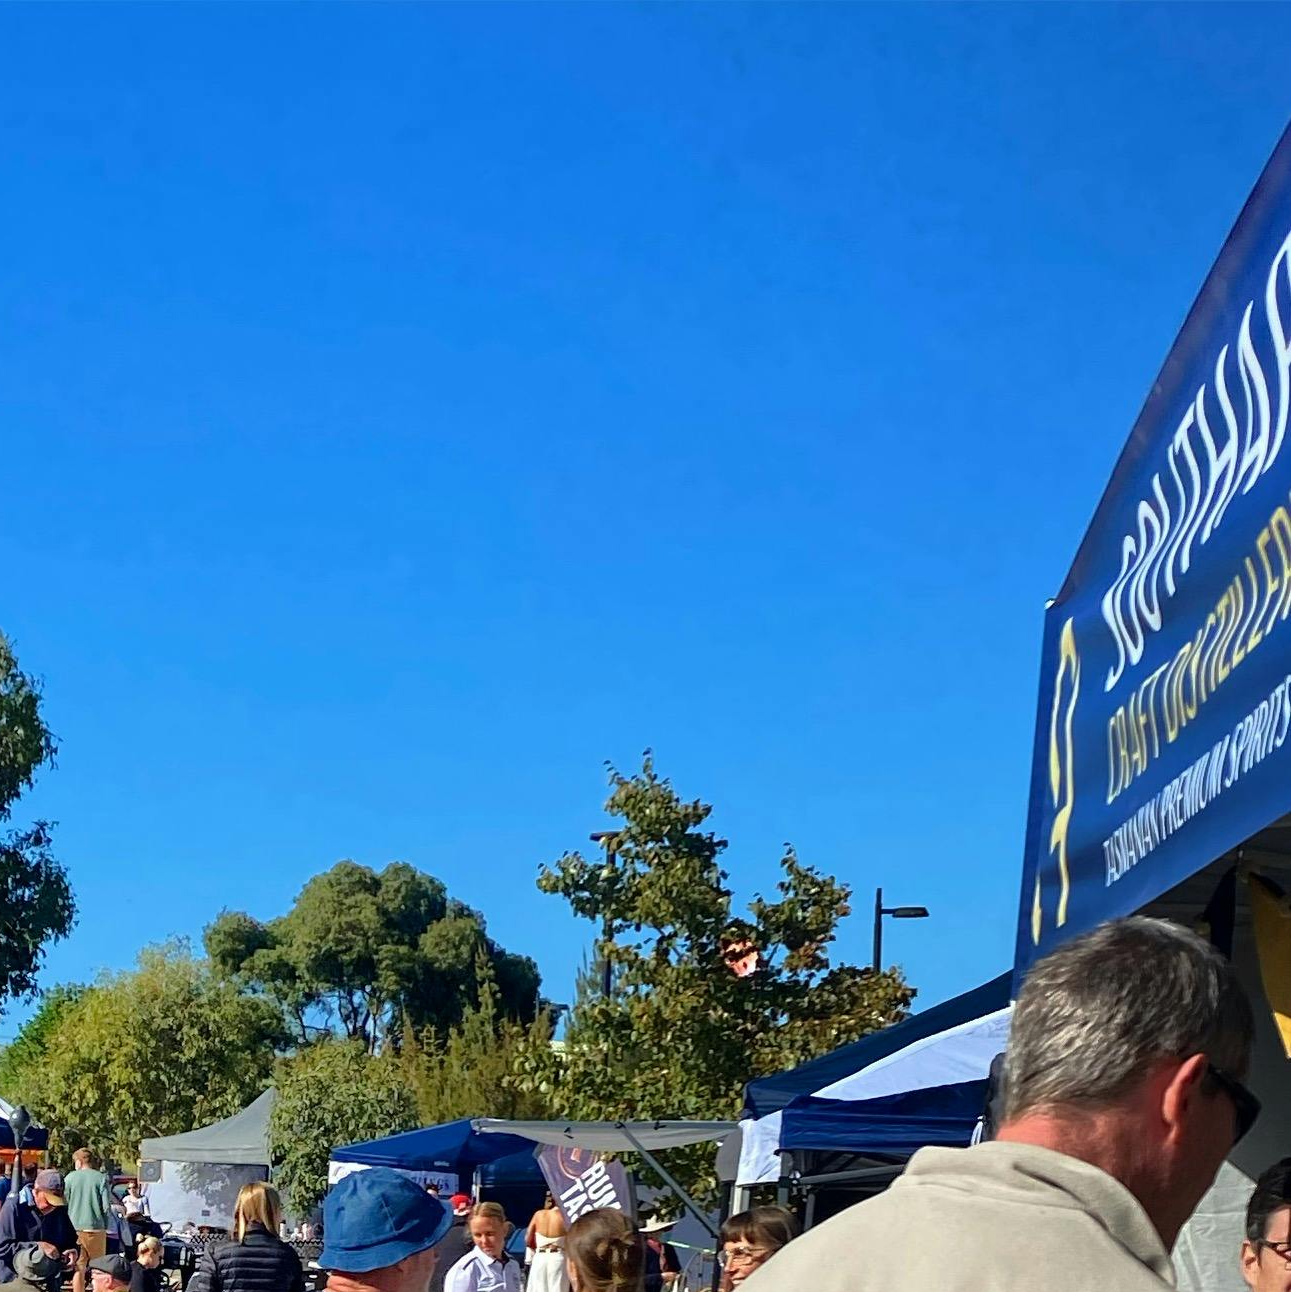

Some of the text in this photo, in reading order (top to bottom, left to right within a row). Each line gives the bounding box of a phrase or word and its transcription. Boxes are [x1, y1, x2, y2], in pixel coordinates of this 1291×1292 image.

[1106, 661, 1169, 805] CRAFT
[1160, 734, 1230, 841] PREMIUM
[1224, 674, 1291, 788] SPIRITS
